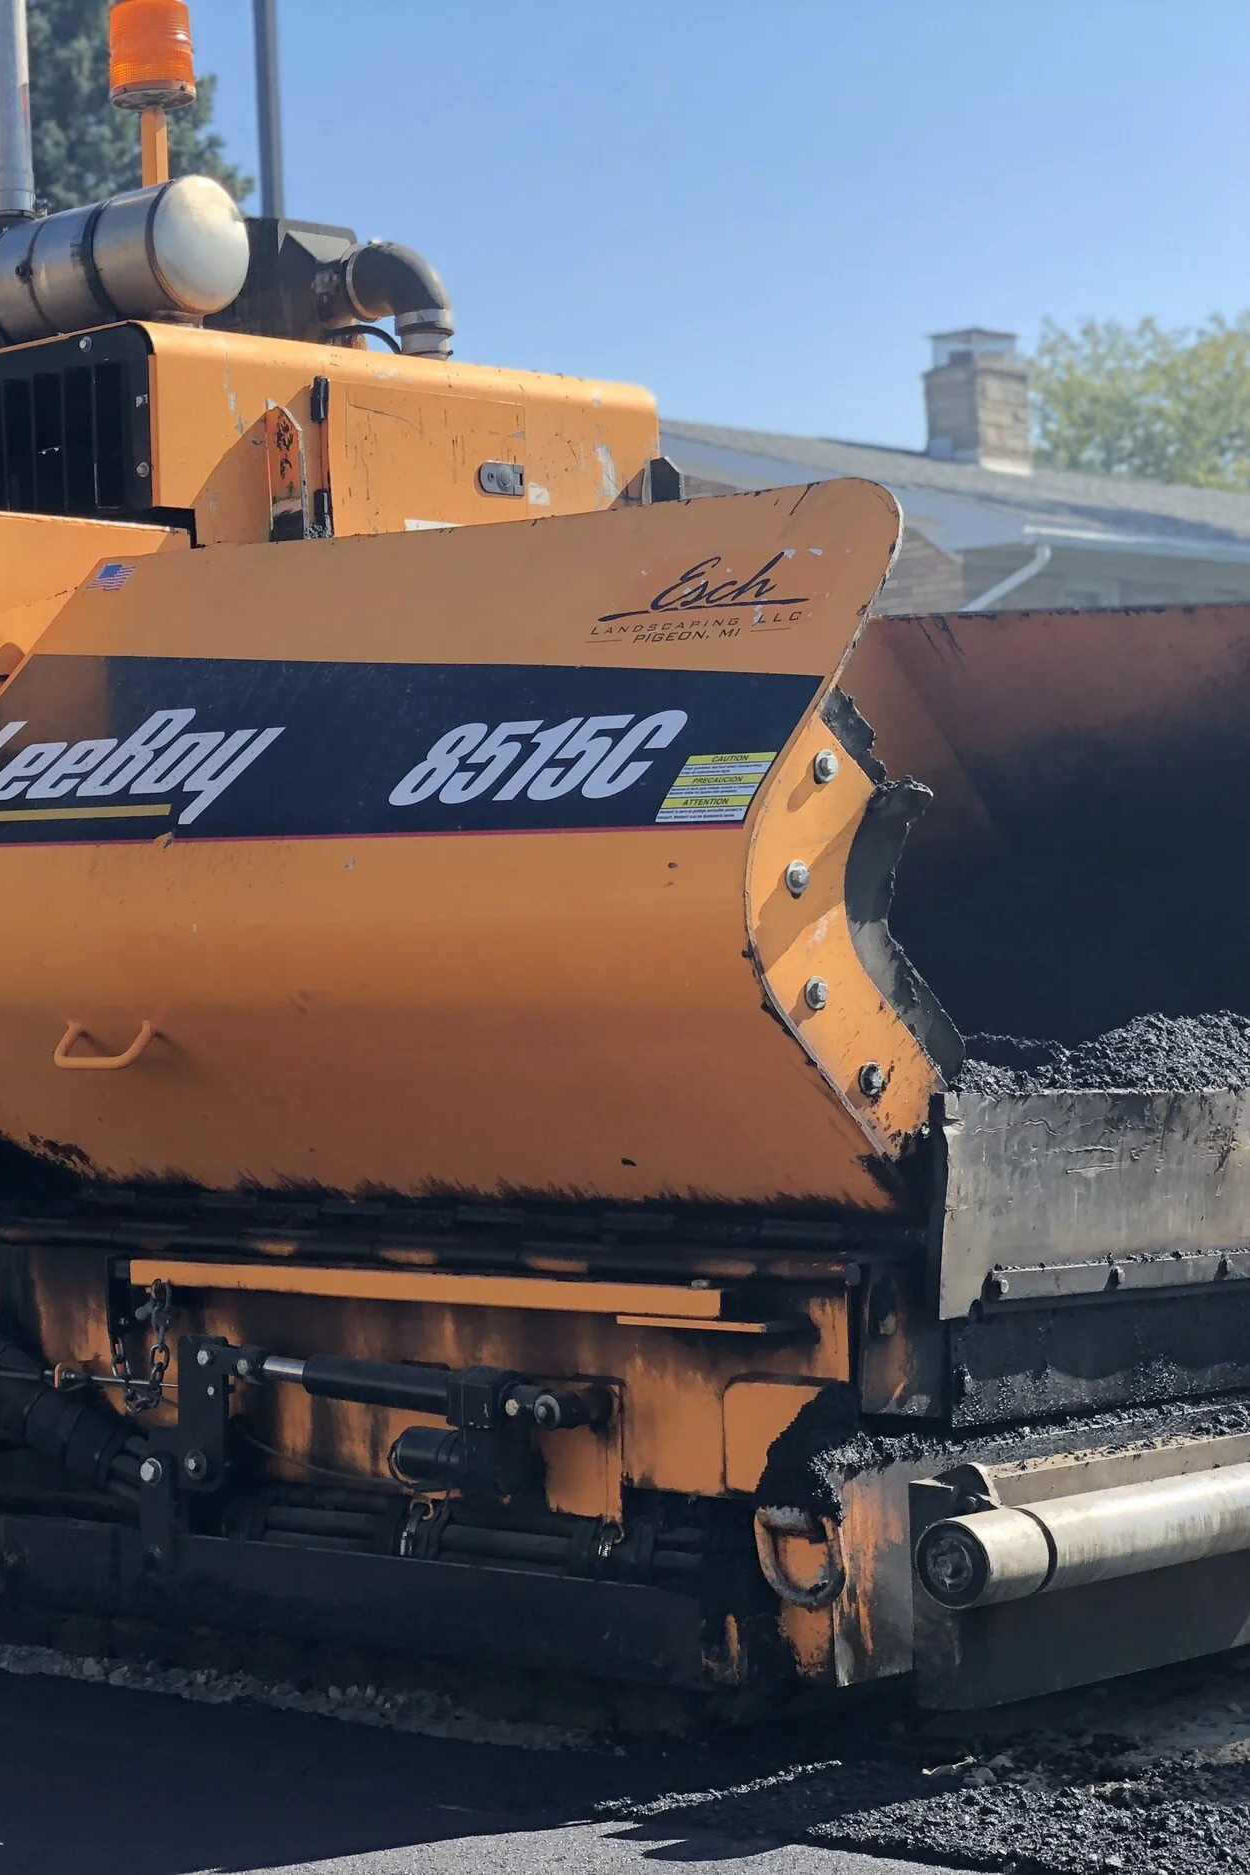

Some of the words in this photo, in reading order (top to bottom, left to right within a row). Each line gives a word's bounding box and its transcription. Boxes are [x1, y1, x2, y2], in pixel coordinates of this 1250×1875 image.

[650, 552, 784, 610] Esch
[591, 617, 740, 635] LANDSCAPING
[754, 611, 802, 625] LLC
[632, 630, 710, 644] PIGEON,
[718, 628, 741, 639] MI
[389, 709, 687, 807] 8515C
[711, 754, 750, 763] CAUTION
[682, 797, 729, 806] ATTENTION
